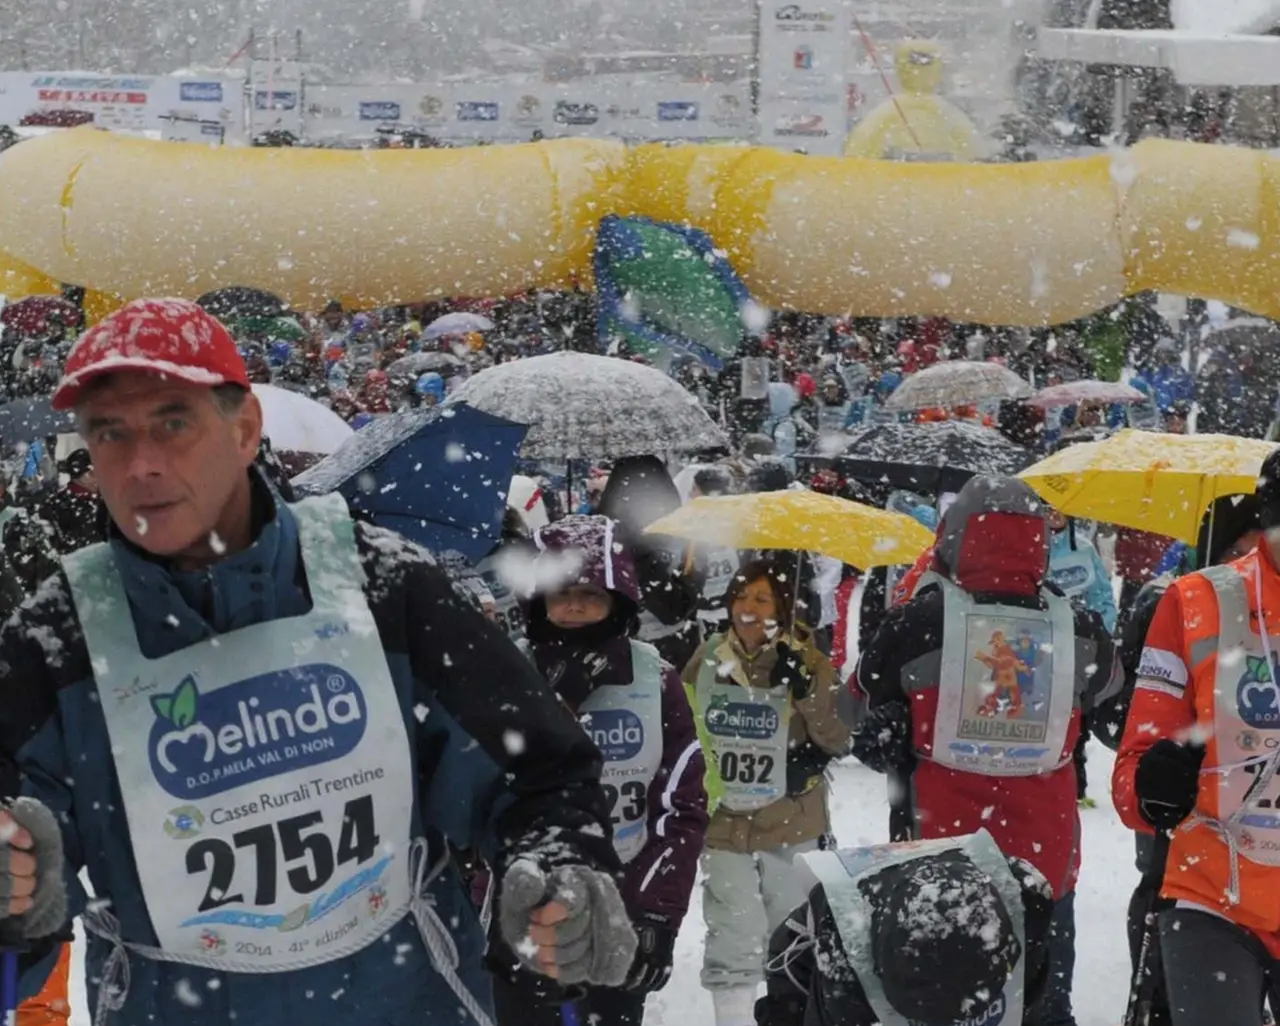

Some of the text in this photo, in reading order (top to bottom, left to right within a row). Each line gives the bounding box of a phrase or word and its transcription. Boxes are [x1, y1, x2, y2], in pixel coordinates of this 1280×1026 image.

[156, 684, 362, 774] Melinda
[257, 750, 282, 767] VAL
[284, 746, 299, 760] DI
[302, 736, 335, 756] NON
[210, 766, 385, 826] Casse Rurali Trentine
[185, 793, 380, 913] 2754
